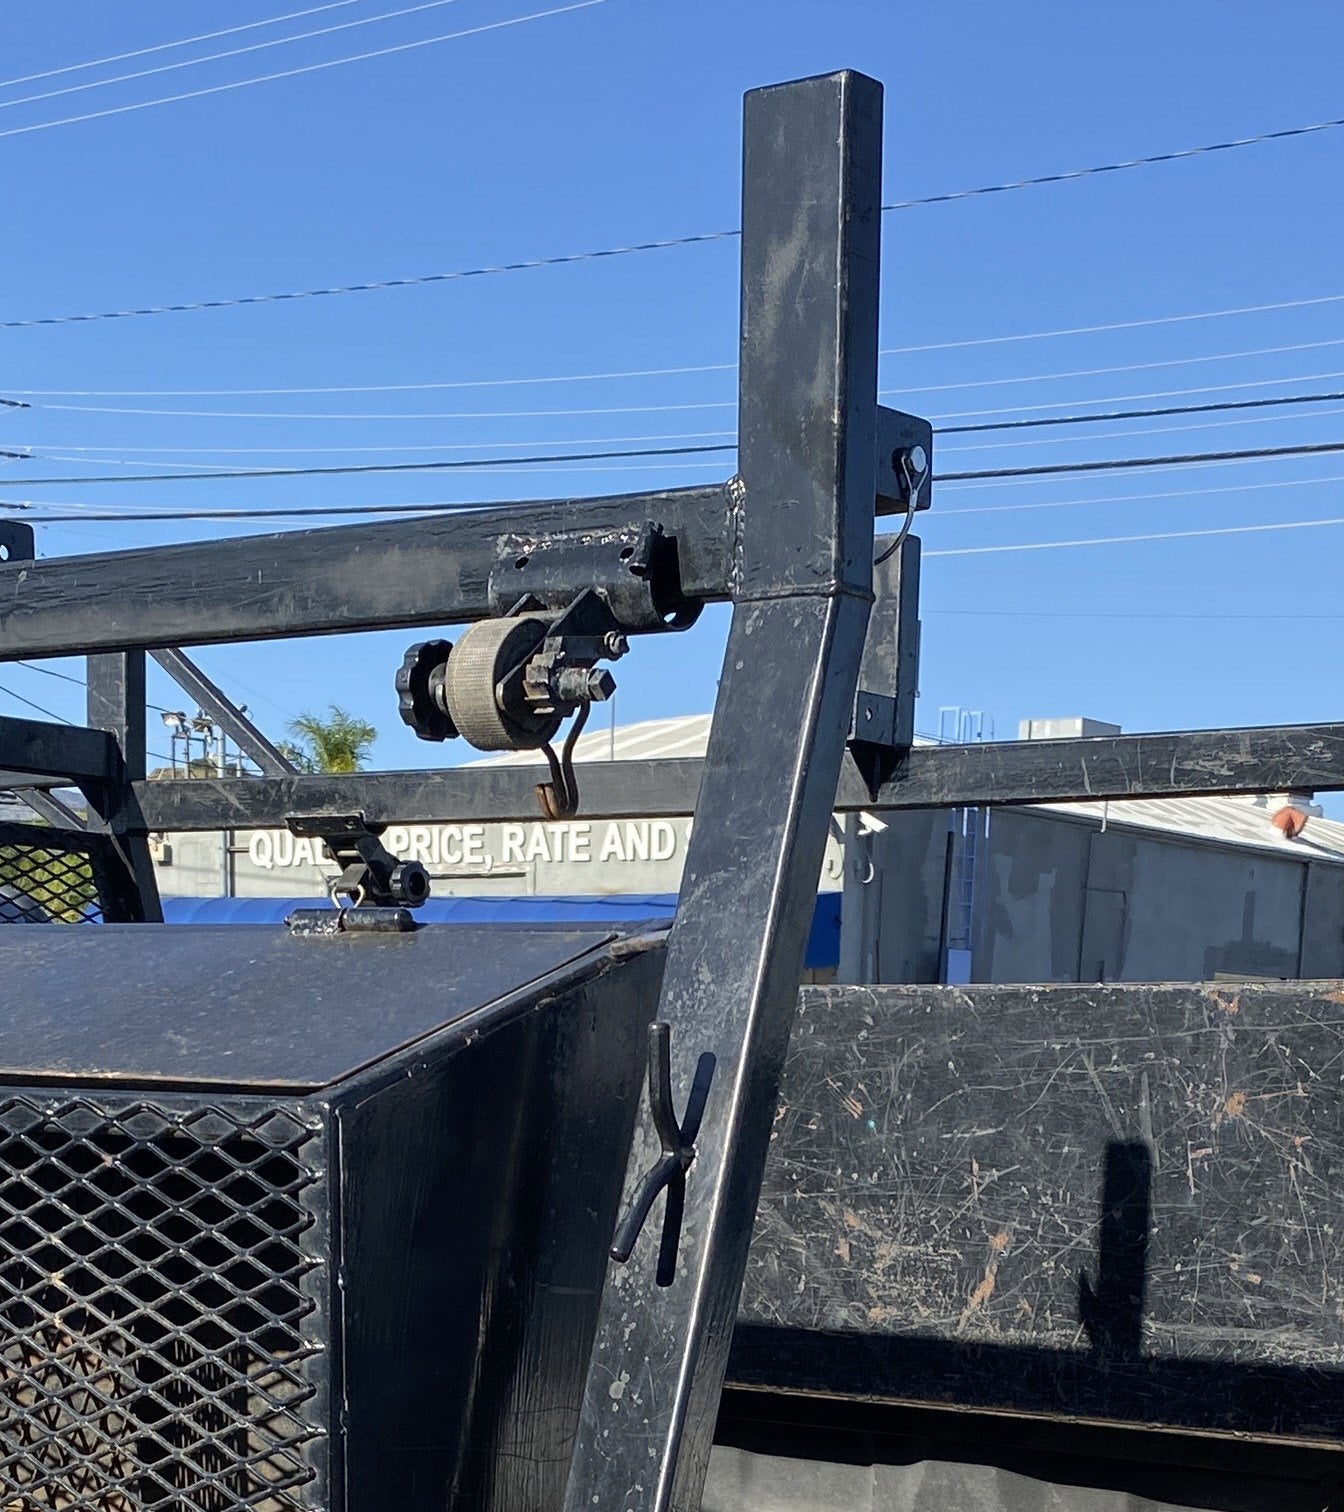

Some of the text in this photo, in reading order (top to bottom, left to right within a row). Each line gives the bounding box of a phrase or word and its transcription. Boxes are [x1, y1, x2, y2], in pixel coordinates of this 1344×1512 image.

[249, 830, 344, 870] QUAL
[389, 826, 493, 875] PRICE,
[502, 822, 591, 863] RATE
[599, 820, 677, 862] AND
